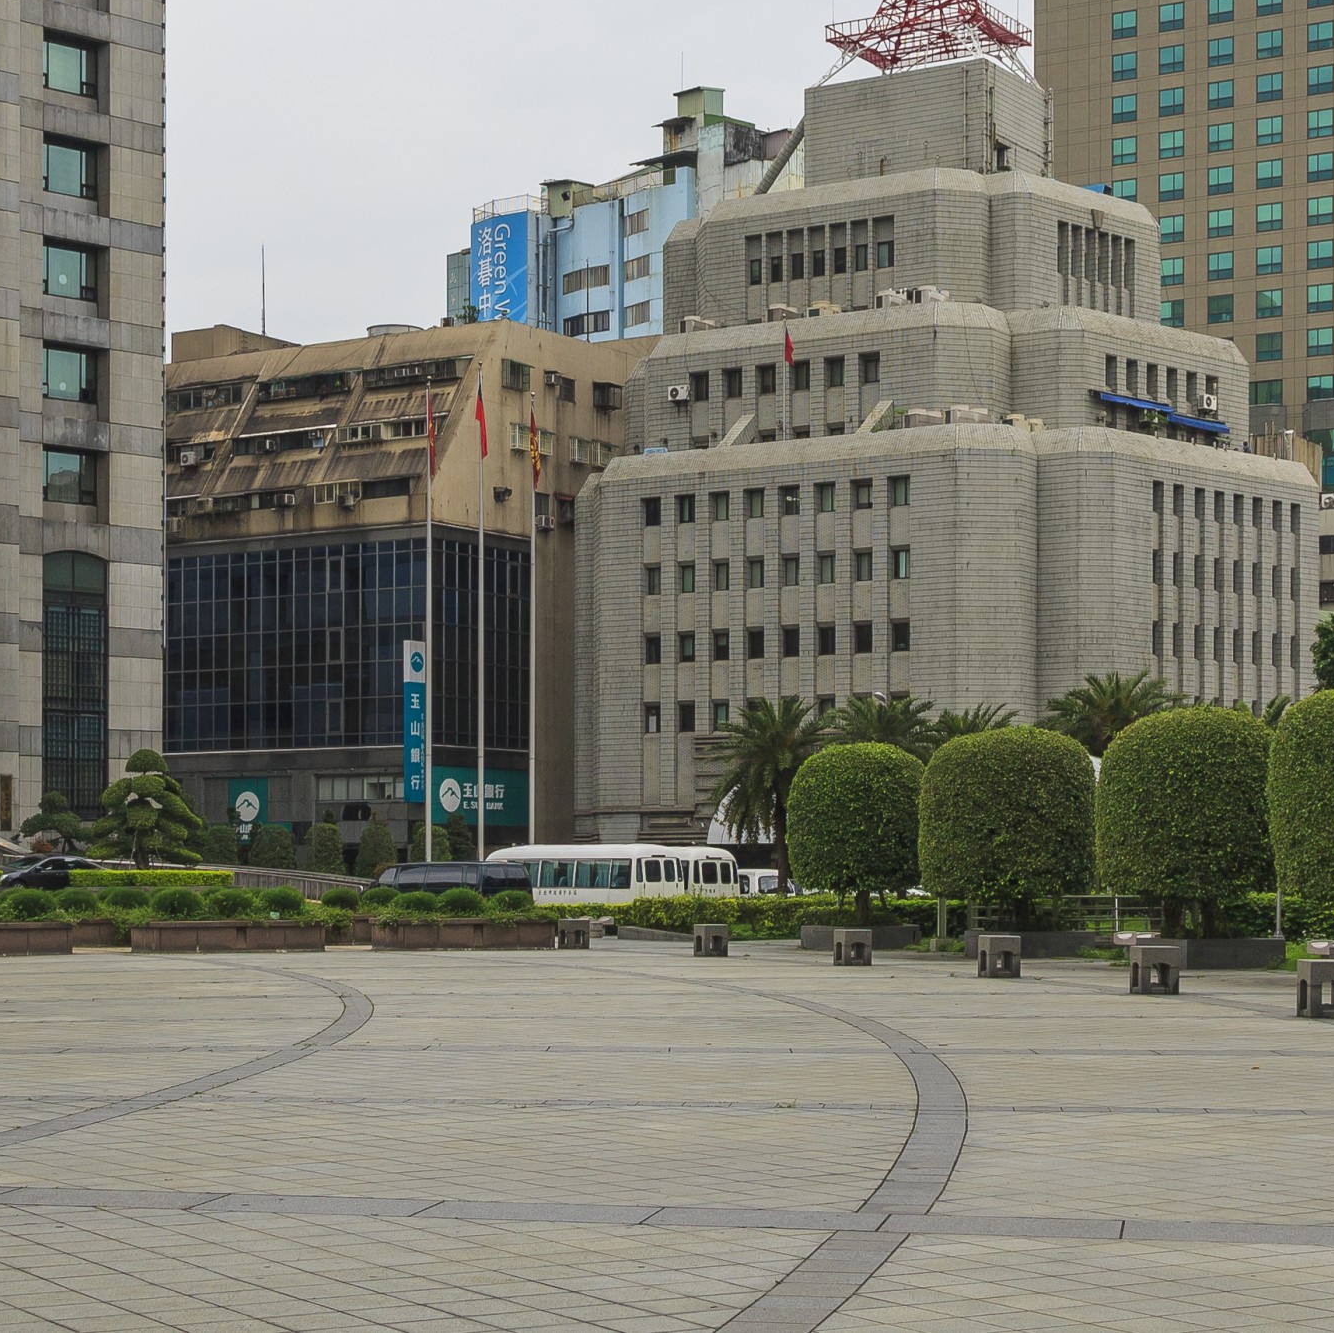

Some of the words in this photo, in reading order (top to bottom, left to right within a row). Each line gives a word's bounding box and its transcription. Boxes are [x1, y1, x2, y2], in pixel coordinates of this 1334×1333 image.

[477, 227, 493, 318] 洛碁中
[494, 223, 511, 295] Green
[410, 693, 420, 790] 玉山銀行
[486, 802, 504, 810] BANK
